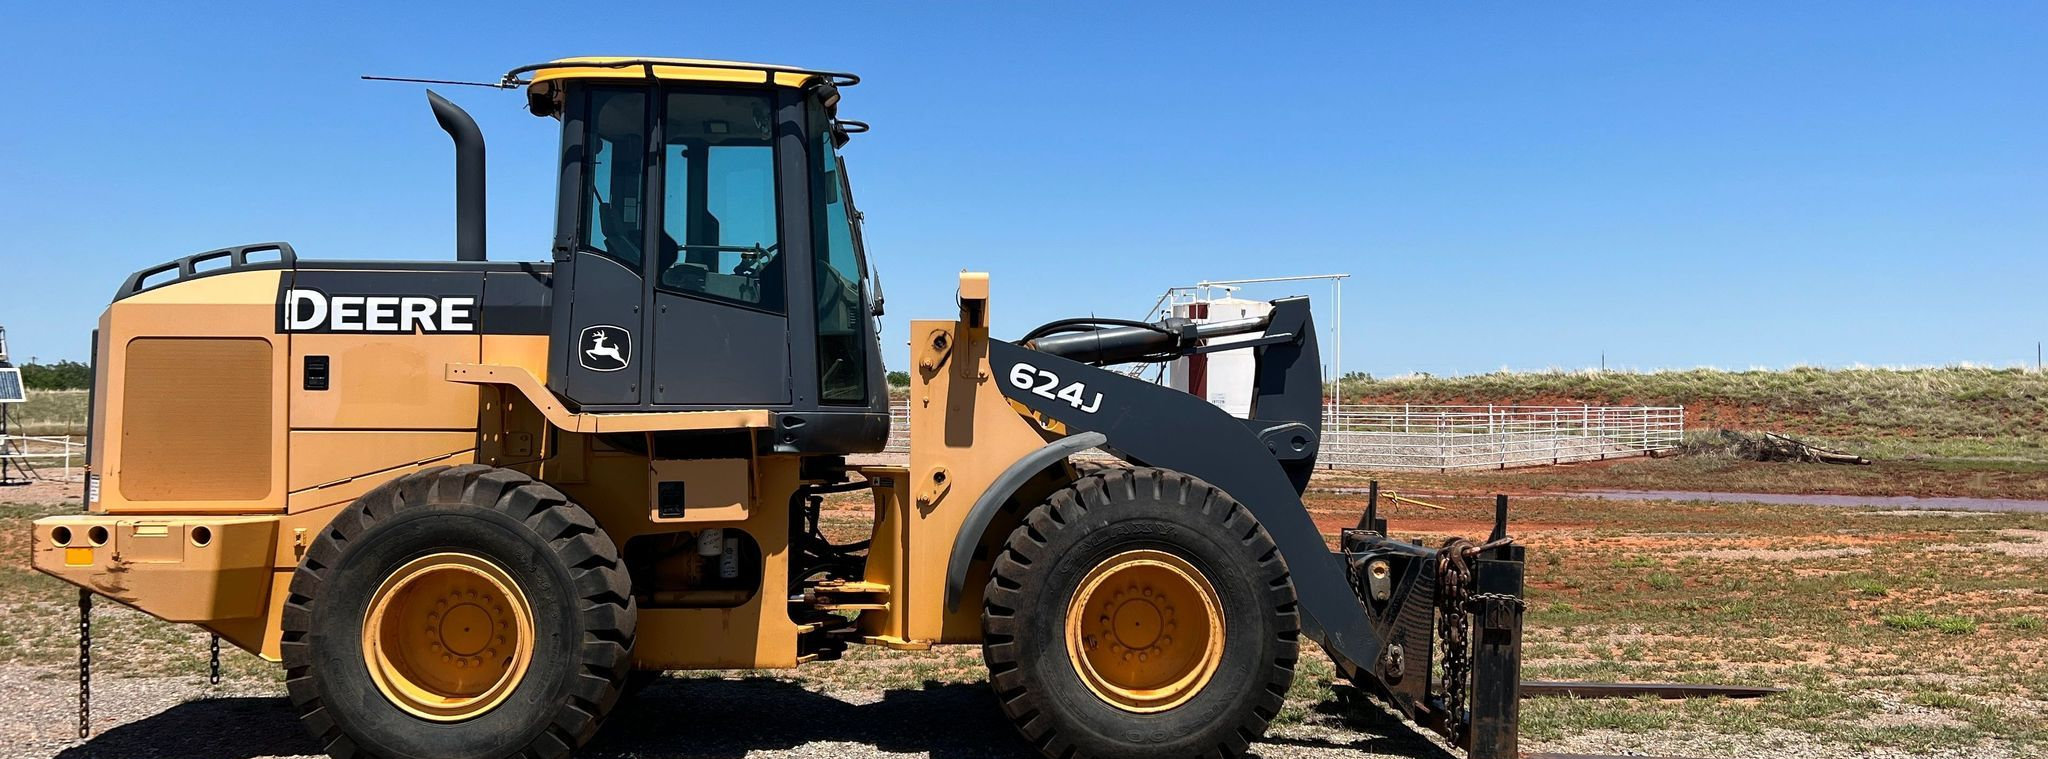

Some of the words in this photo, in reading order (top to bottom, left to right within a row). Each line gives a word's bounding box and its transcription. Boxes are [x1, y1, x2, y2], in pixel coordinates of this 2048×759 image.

[285, 289, 474, 331] DEERE
[1009, 362, 1104, 414] 624J
[1062, 521, 1176, 574] GALAXY
